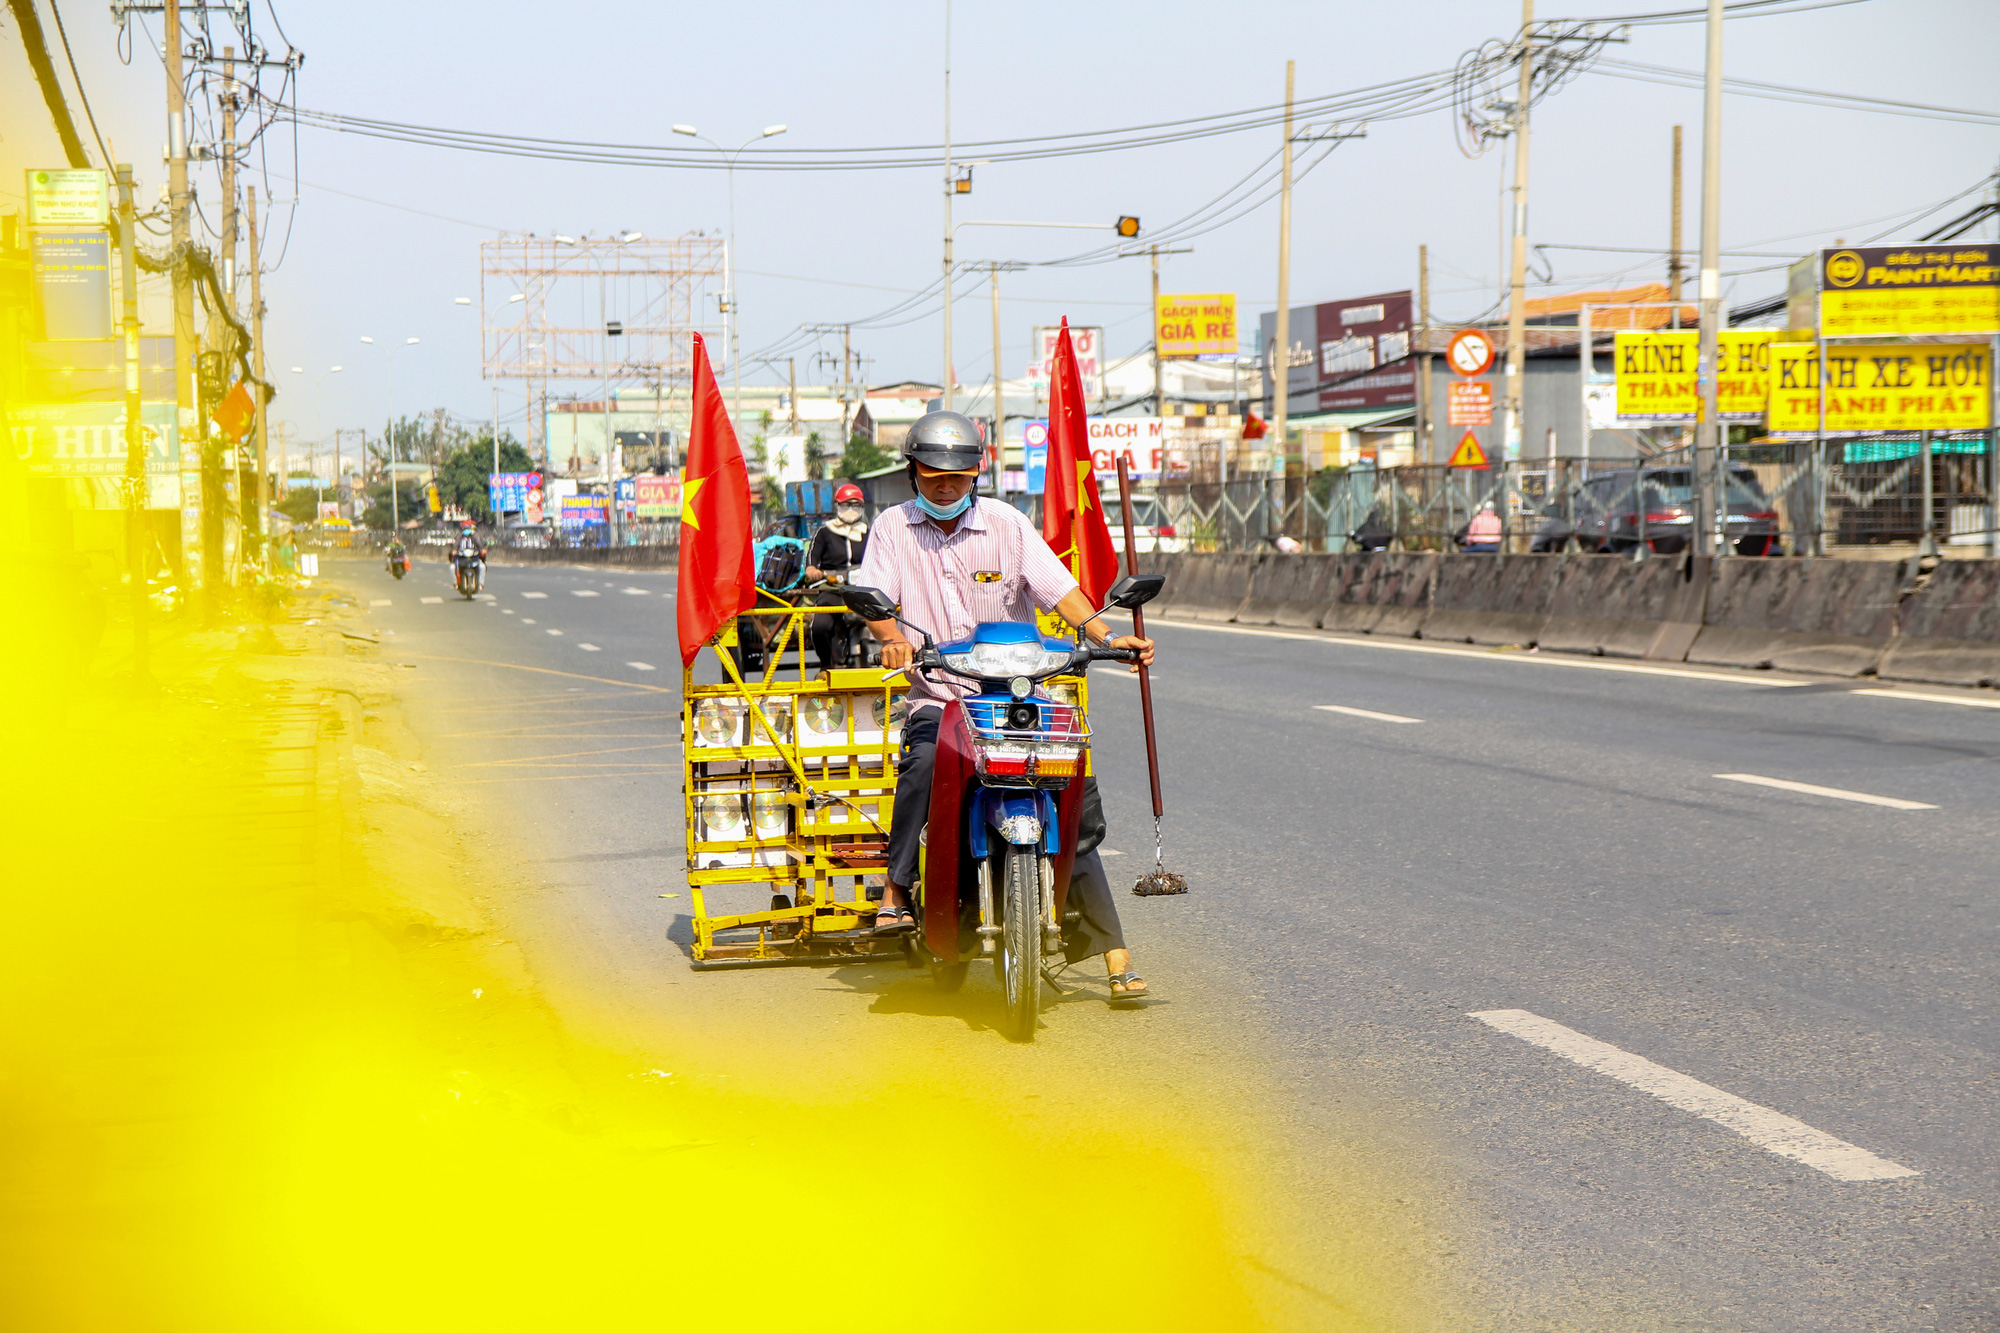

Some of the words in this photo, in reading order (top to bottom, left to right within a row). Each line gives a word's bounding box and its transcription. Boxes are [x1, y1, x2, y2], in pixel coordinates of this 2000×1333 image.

[1160, 320, 1196, 340] GIÁ
[1623, 337, 1684, 373] KÍNH
[1870, 356, 1915, 387] XE
[1091, 442, 1137, 471] GIÁ
